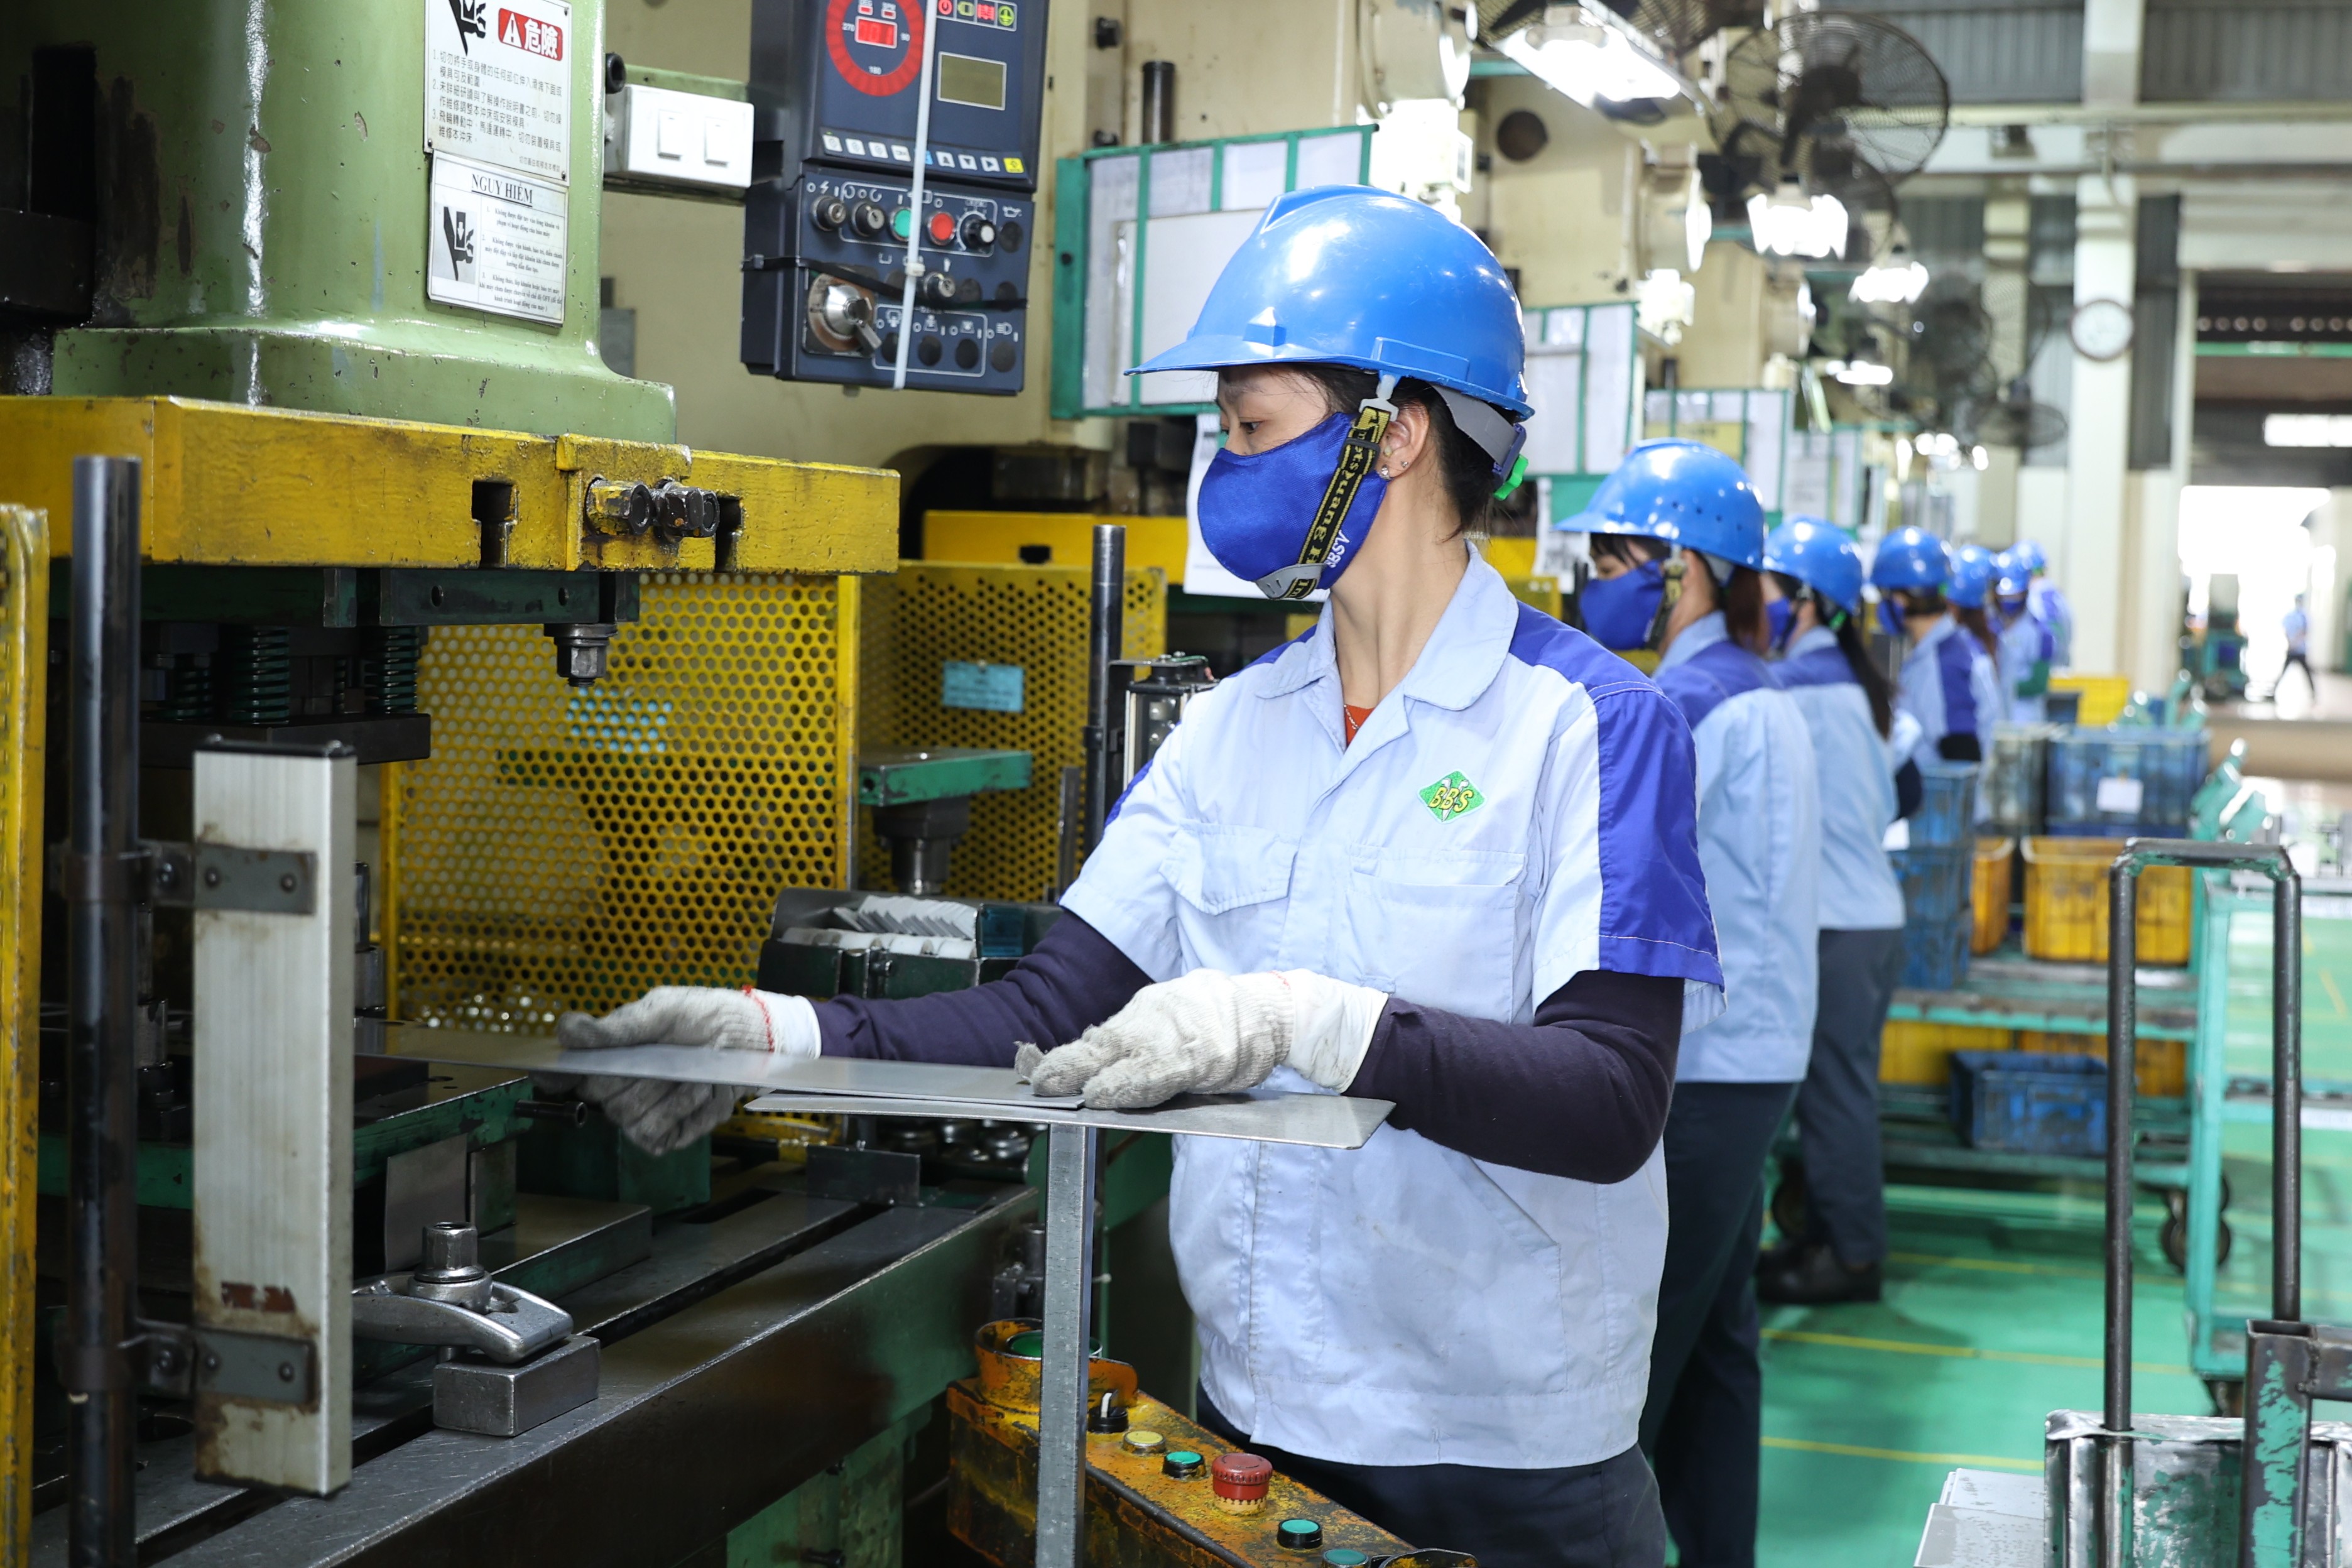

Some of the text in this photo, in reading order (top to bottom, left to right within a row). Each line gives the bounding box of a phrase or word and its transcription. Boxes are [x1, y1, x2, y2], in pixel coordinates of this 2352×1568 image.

[524, 19, 558, 59] 危險
[472, 174, 532, 204] NGUY HIỂM
[1427, 786, 1474, 813] BBS
